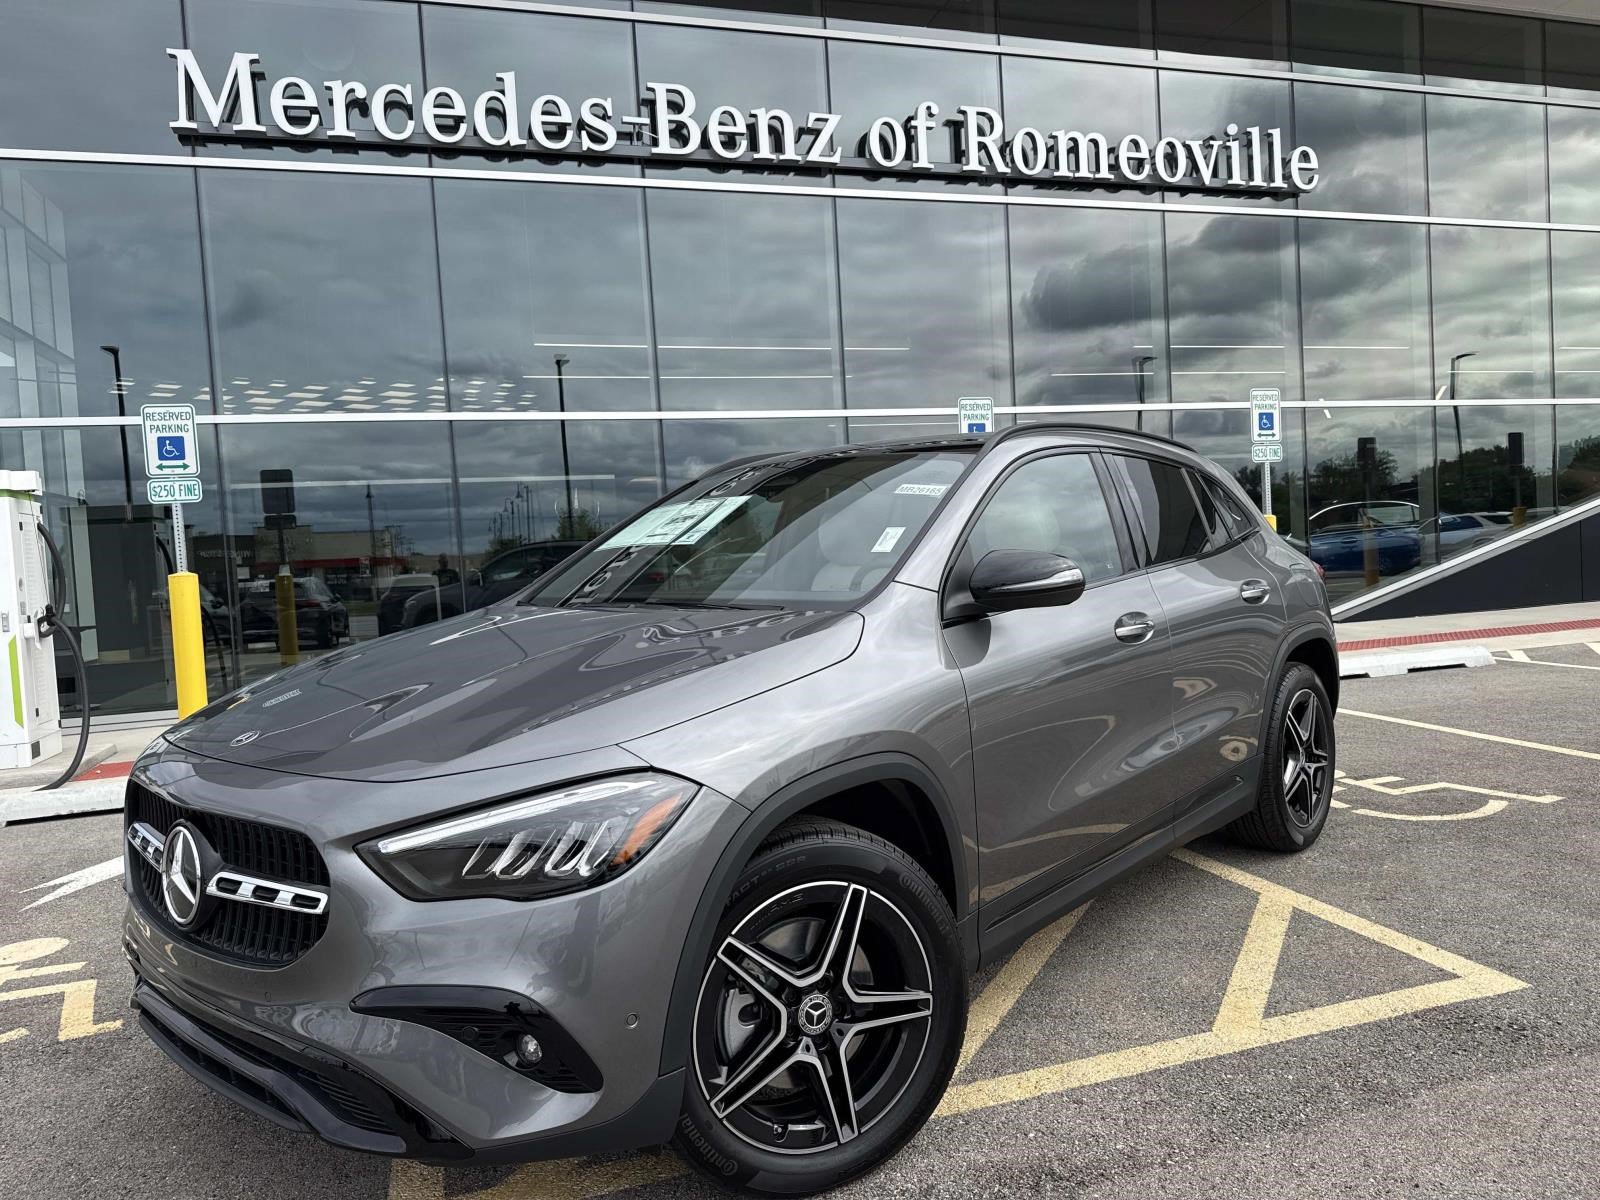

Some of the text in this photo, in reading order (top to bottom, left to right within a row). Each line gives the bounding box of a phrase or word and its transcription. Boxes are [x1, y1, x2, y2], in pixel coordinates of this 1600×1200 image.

[166, 47, 1320, 190] Mercedes-Benz of Romeoville
[1252, 394, 1278, 402] RESERVED
[960, 403, 991, 411] RESERVED
[1254, 403, 1277, 411] PARKING
[145, 411, 191, 422] RESERVED
[963, 413, 990, 422] PARKING
[149, 424, 190, 434] PARKING
[1254, 447, 1280, 458] $250 FINE
[151, 483, 199, 498] $250 FINE
[680, 1113, 738, 1176] Continental
